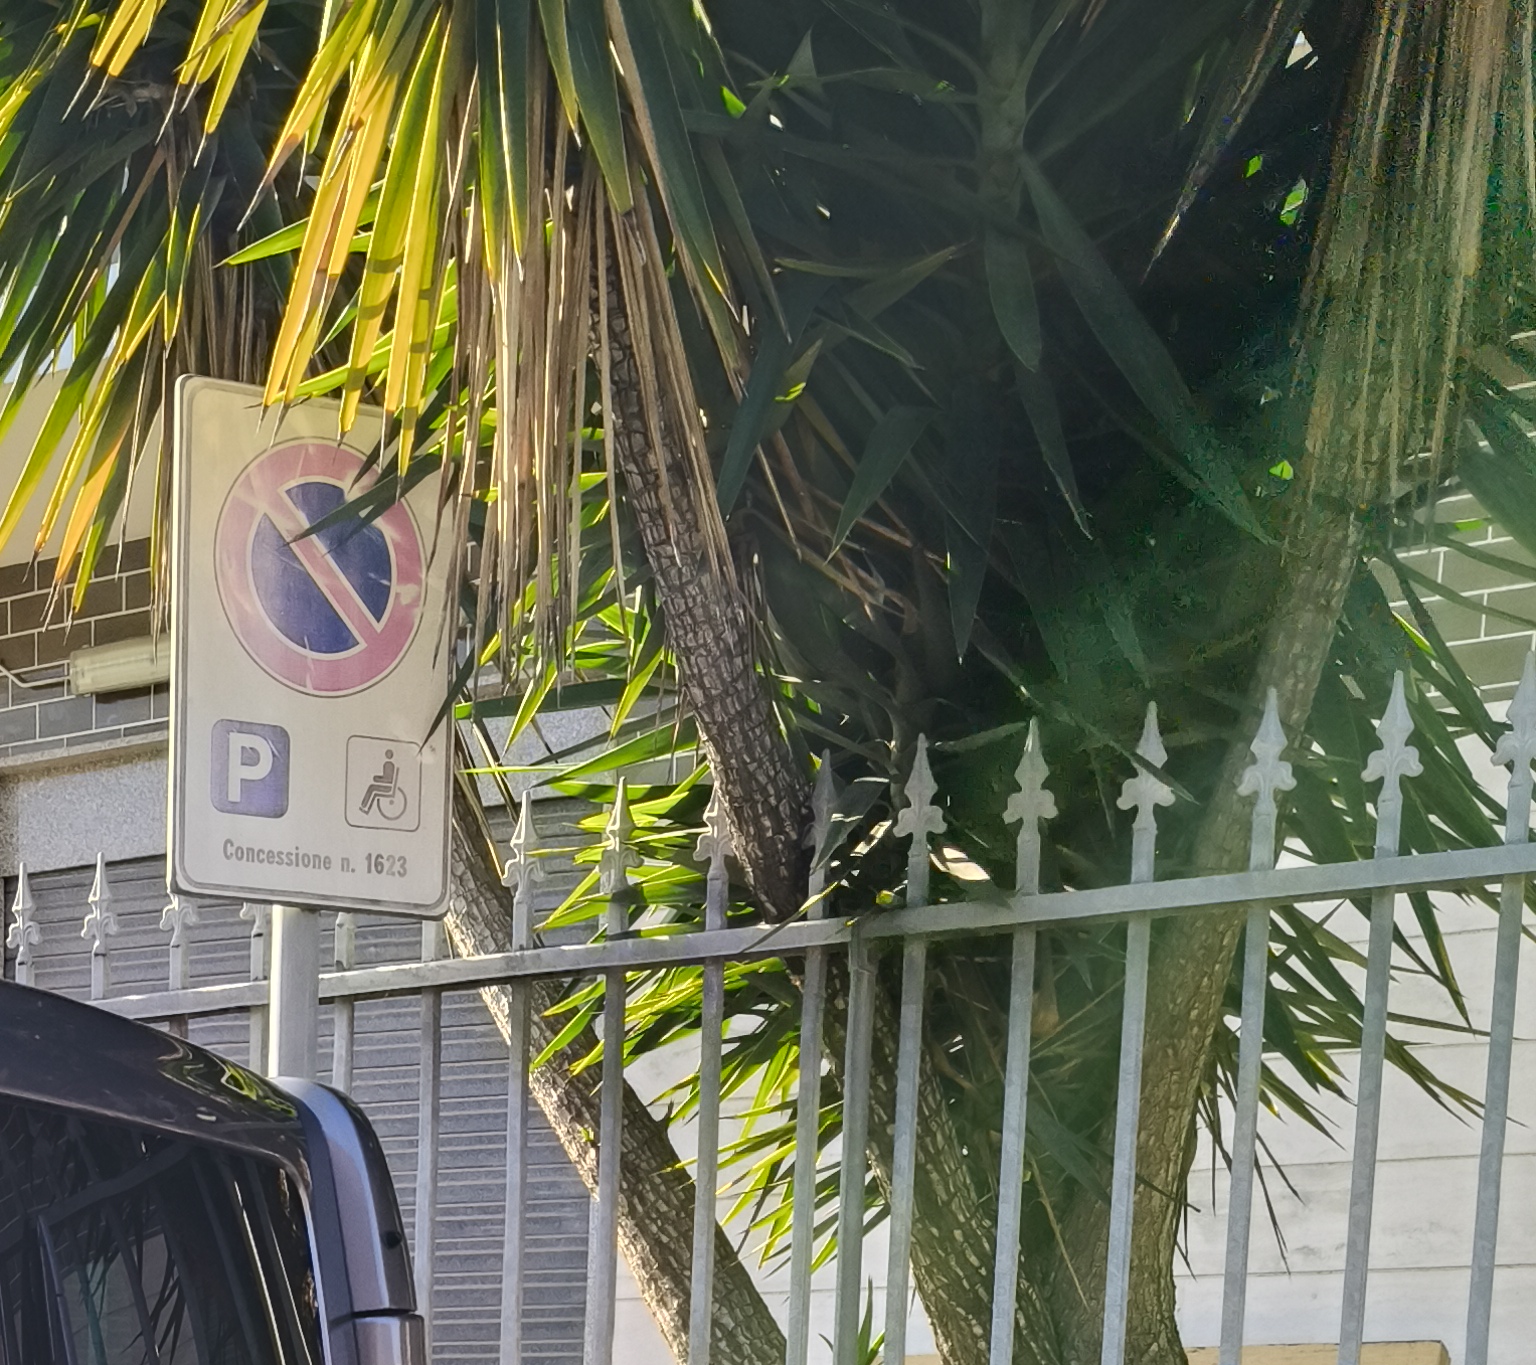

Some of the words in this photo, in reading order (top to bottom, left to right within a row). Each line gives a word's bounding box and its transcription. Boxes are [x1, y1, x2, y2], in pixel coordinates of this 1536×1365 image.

[227, 731, 273, 803] P
[223, 838, 332, 871] Concessione
[340, 855, 356, 874] n.
[365, 852, 408, 878] 1623
